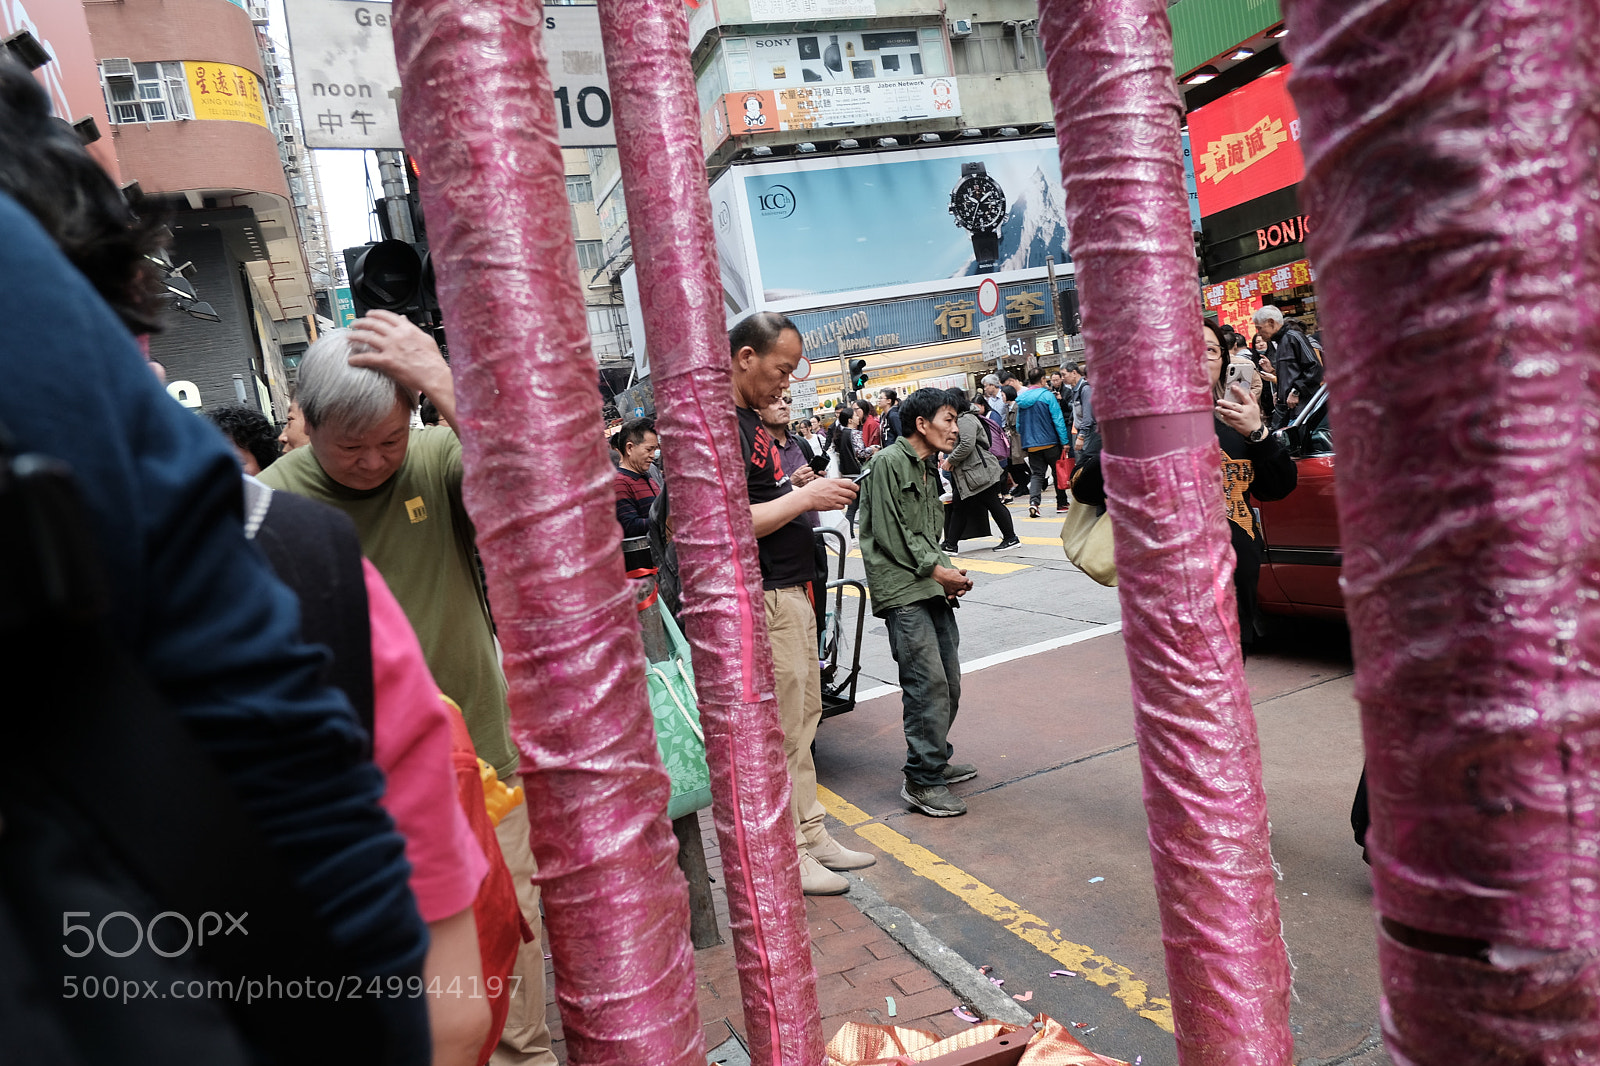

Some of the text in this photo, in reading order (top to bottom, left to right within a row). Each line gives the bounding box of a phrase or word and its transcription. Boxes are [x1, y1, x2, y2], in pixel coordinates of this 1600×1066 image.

[755, 38, 793, 49] SONY
[312, 82, 372, 99] noon
[877, 82, 897, 91] Jaben
[899, 80, 925, 89] Network
[202, 98, 222, 107] XING
[554, 86, 612, 129] 10
[318, 109, 376, 135] 中午
[802, 310, 869, 352] HOLLYWOOD
[841, 332, 900, 351] HOPPING CENTRE
